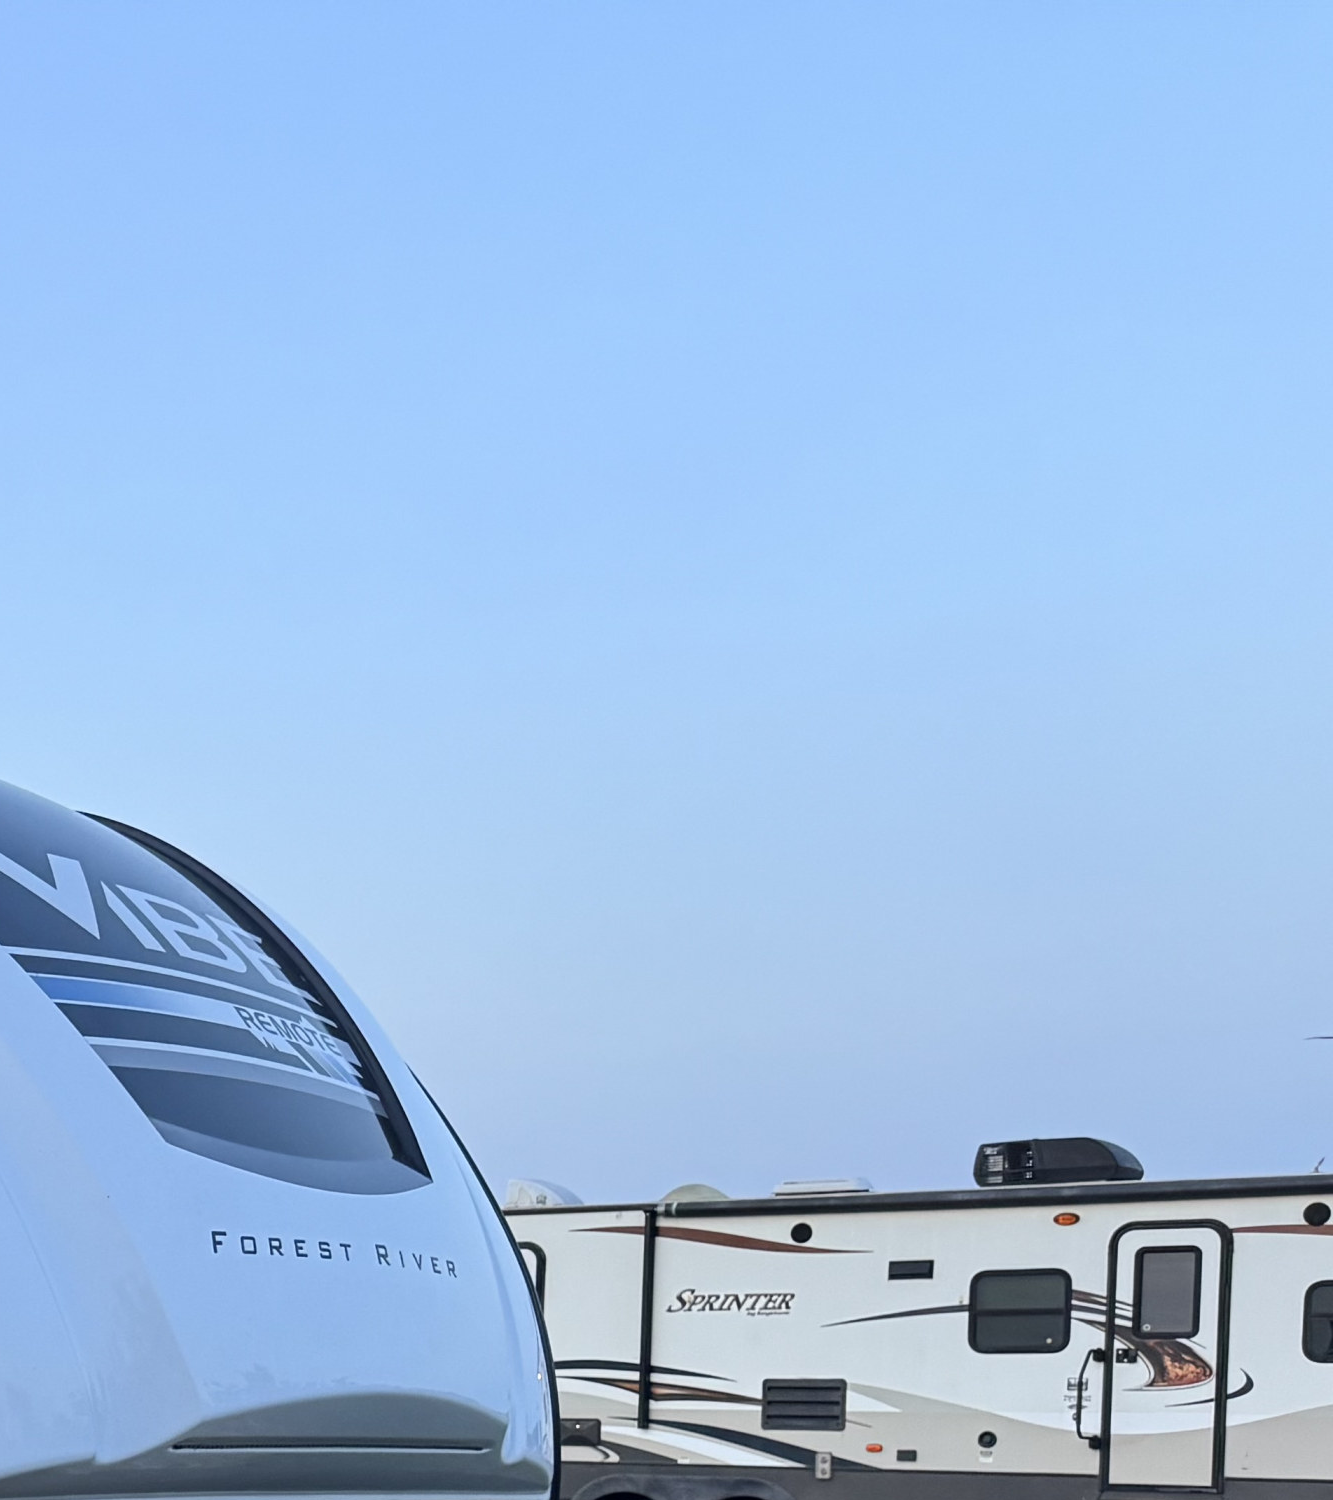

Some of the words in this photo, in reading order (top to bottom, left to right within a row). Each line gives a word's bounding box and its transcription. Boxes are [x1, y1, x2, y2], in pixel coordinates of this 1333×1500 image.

[233, 1005, 342, 1057] REMOTE
[210, 1230, 352, 1262] FOREST
[374, 1243, 458, 1279] RIVER
[666, 1288, 796, 1313] SPRINTER
